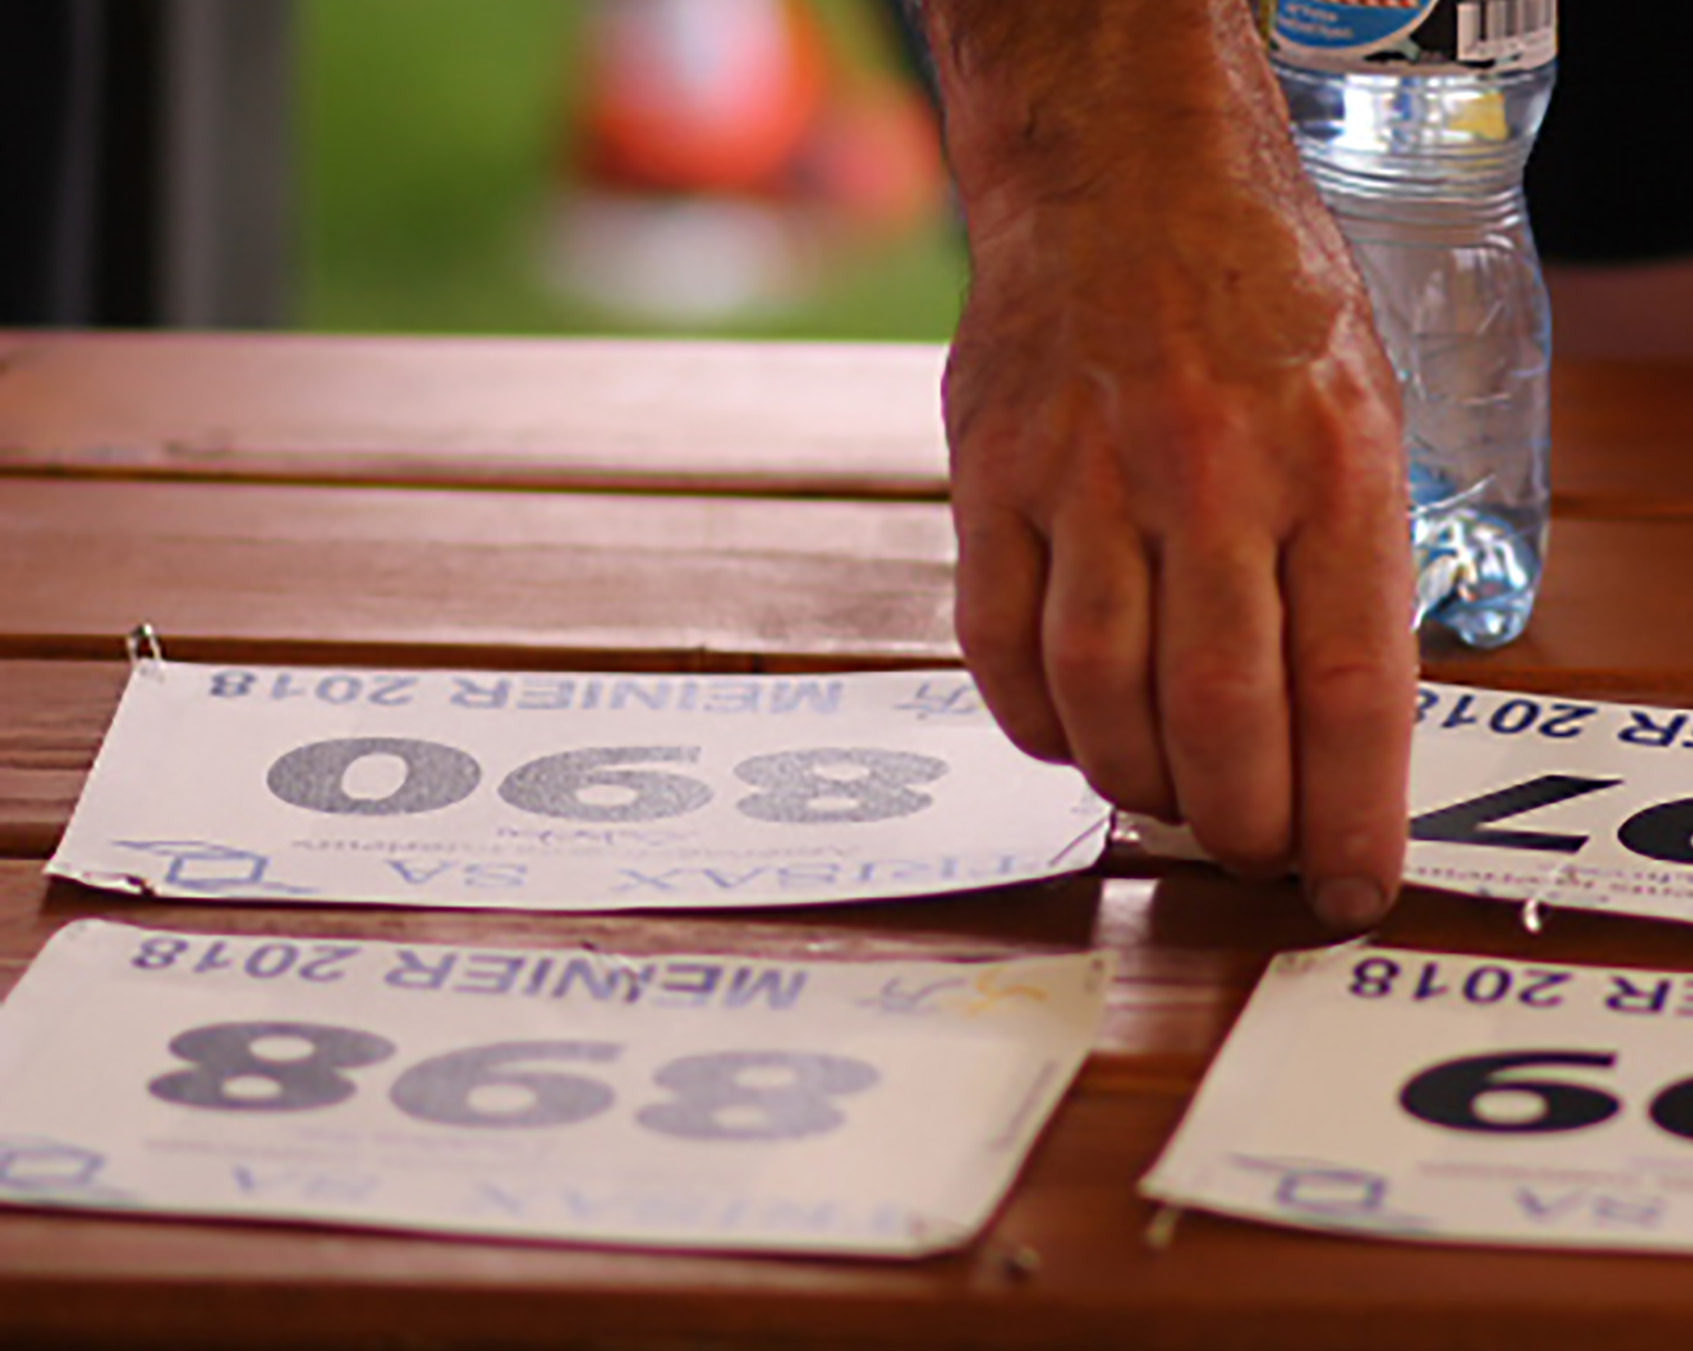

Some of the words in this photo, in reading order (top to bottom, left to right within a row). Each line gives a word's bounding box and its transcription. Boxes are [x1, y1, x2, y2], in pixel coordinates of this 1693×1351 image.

[208, 669, 419, 709] 2018
[452, 673, 841, 715] MEINIER
[266, 736, 950, 825] 890
[385, 858, 528, 891] SA
[132, 936, 355, 981] 2018
[384, 950, 808, 1010] MEINIER
[1347, 957, 1572, 1009] 2018
[148, 1021, 880, 1144] 898
